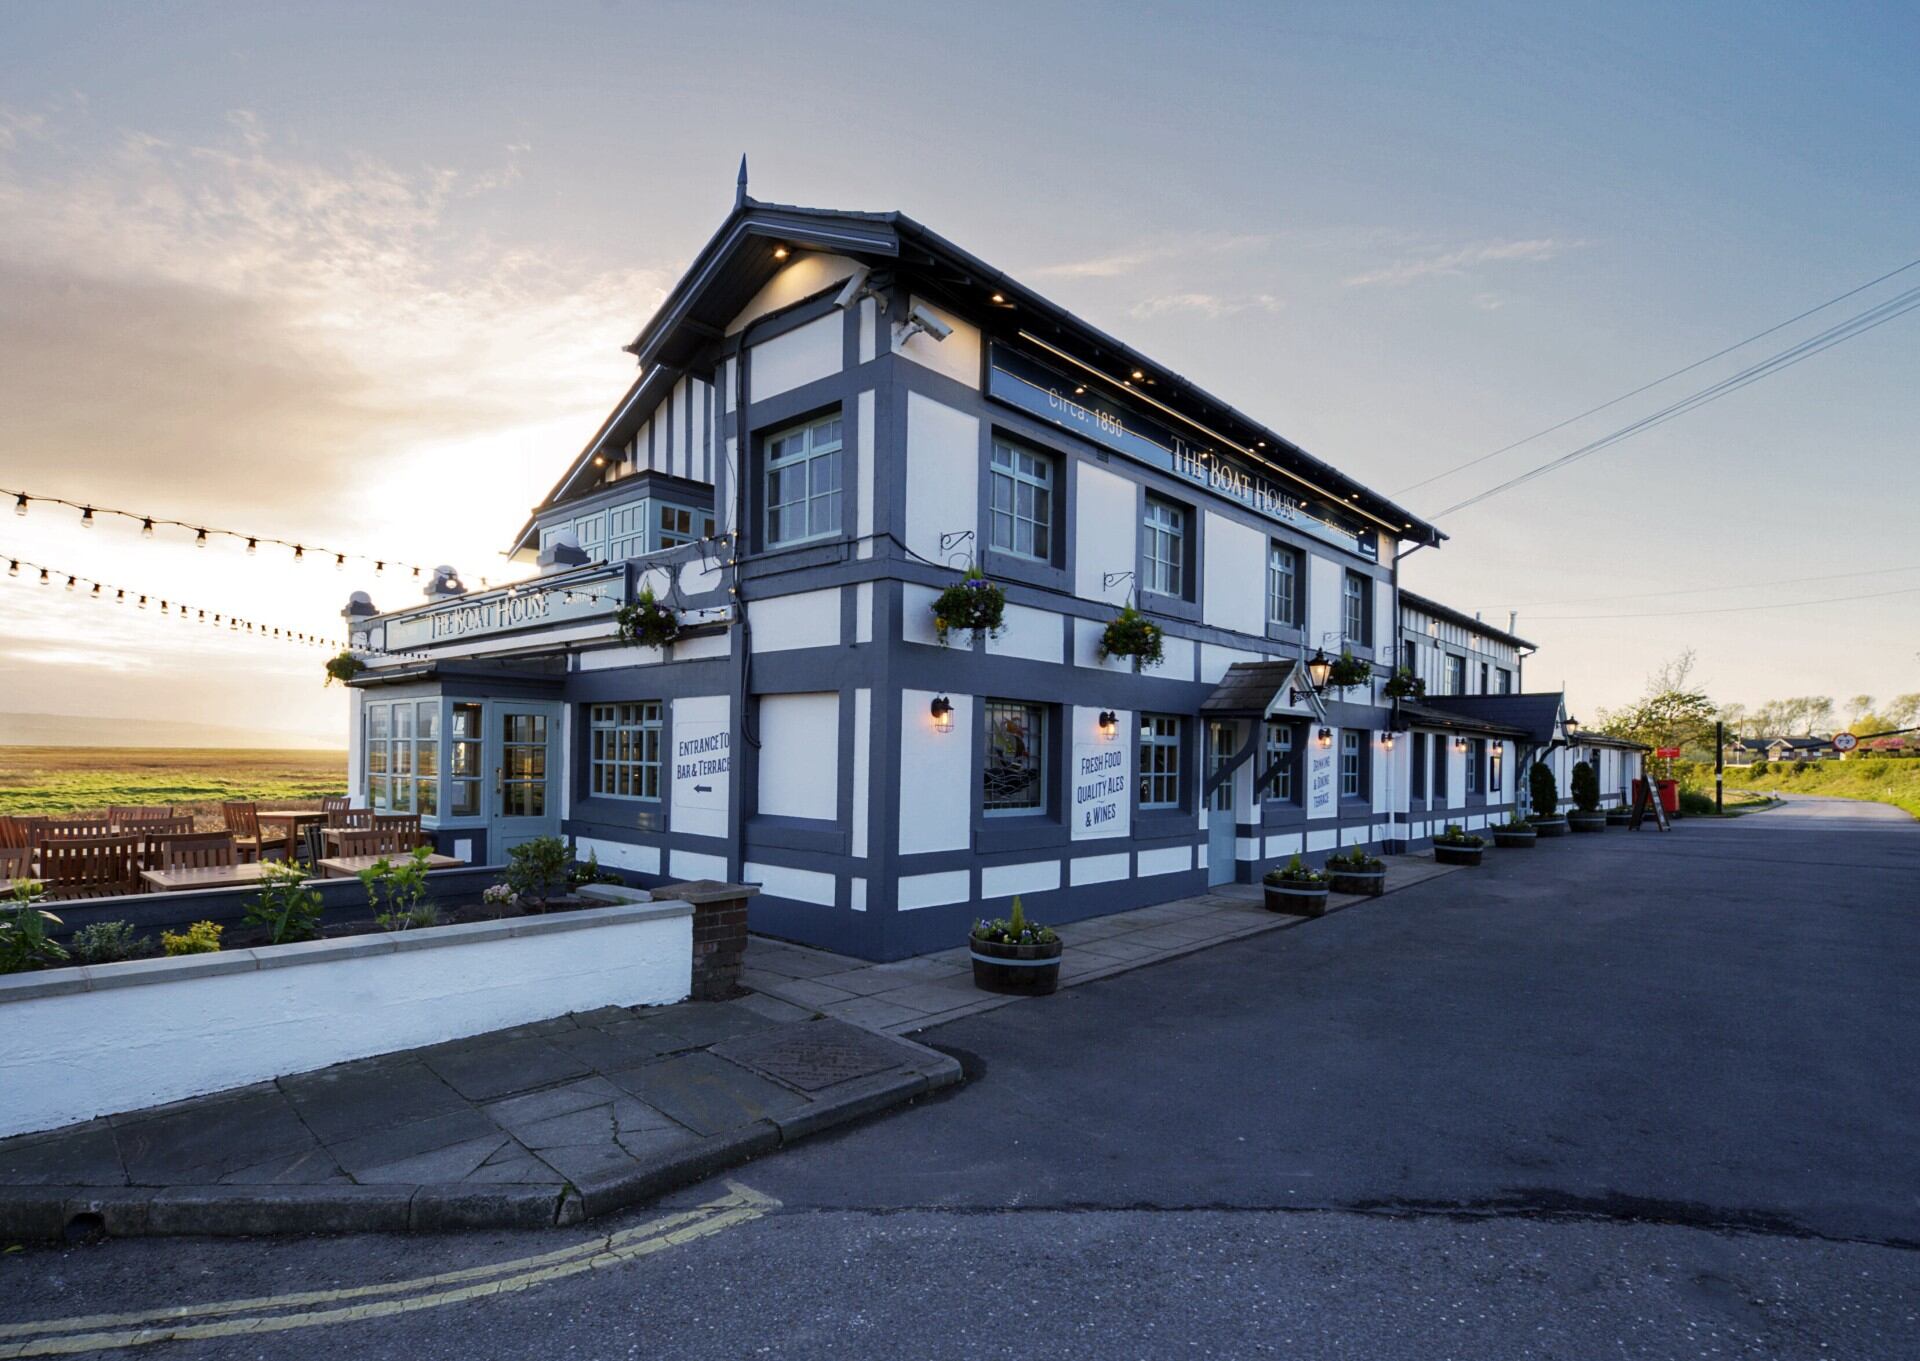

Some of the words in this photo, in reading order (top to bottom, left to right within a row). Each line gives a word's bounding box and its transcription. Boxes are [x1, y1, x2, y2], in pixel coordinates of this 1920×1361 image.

[1048, 387, 1089, 423] Circa.
[1095, 408, 1122, 437] 1850
[1170, 435, 1205, 479] THE
[1208, 453, 1251, 499] BOAT
[1254, 478, 1297, 521] HOUSE
[426, 612, 454, 639] THE
[452, 602, 496, 635] BOAT
[496, 592, 549, 626] HOUSE
[679, 735, 719, 756] ENTRANCE
[719, 732, 730, 749] TO
[677, 764, 691, 779] BAR
[691, 763, 697, 777] &
[697, 757, 730, 776] TERRACE
[1081, 755, 1104, 775] FRESH
[1104, 751, 1122, 769] FOOD
[1077, 781, 1107, 804] QUALITY
[1107, 776, 1124, 795] ALES
[1085, 811, 1092, 827] &
[1093, 803, 1116, 825] WINES
